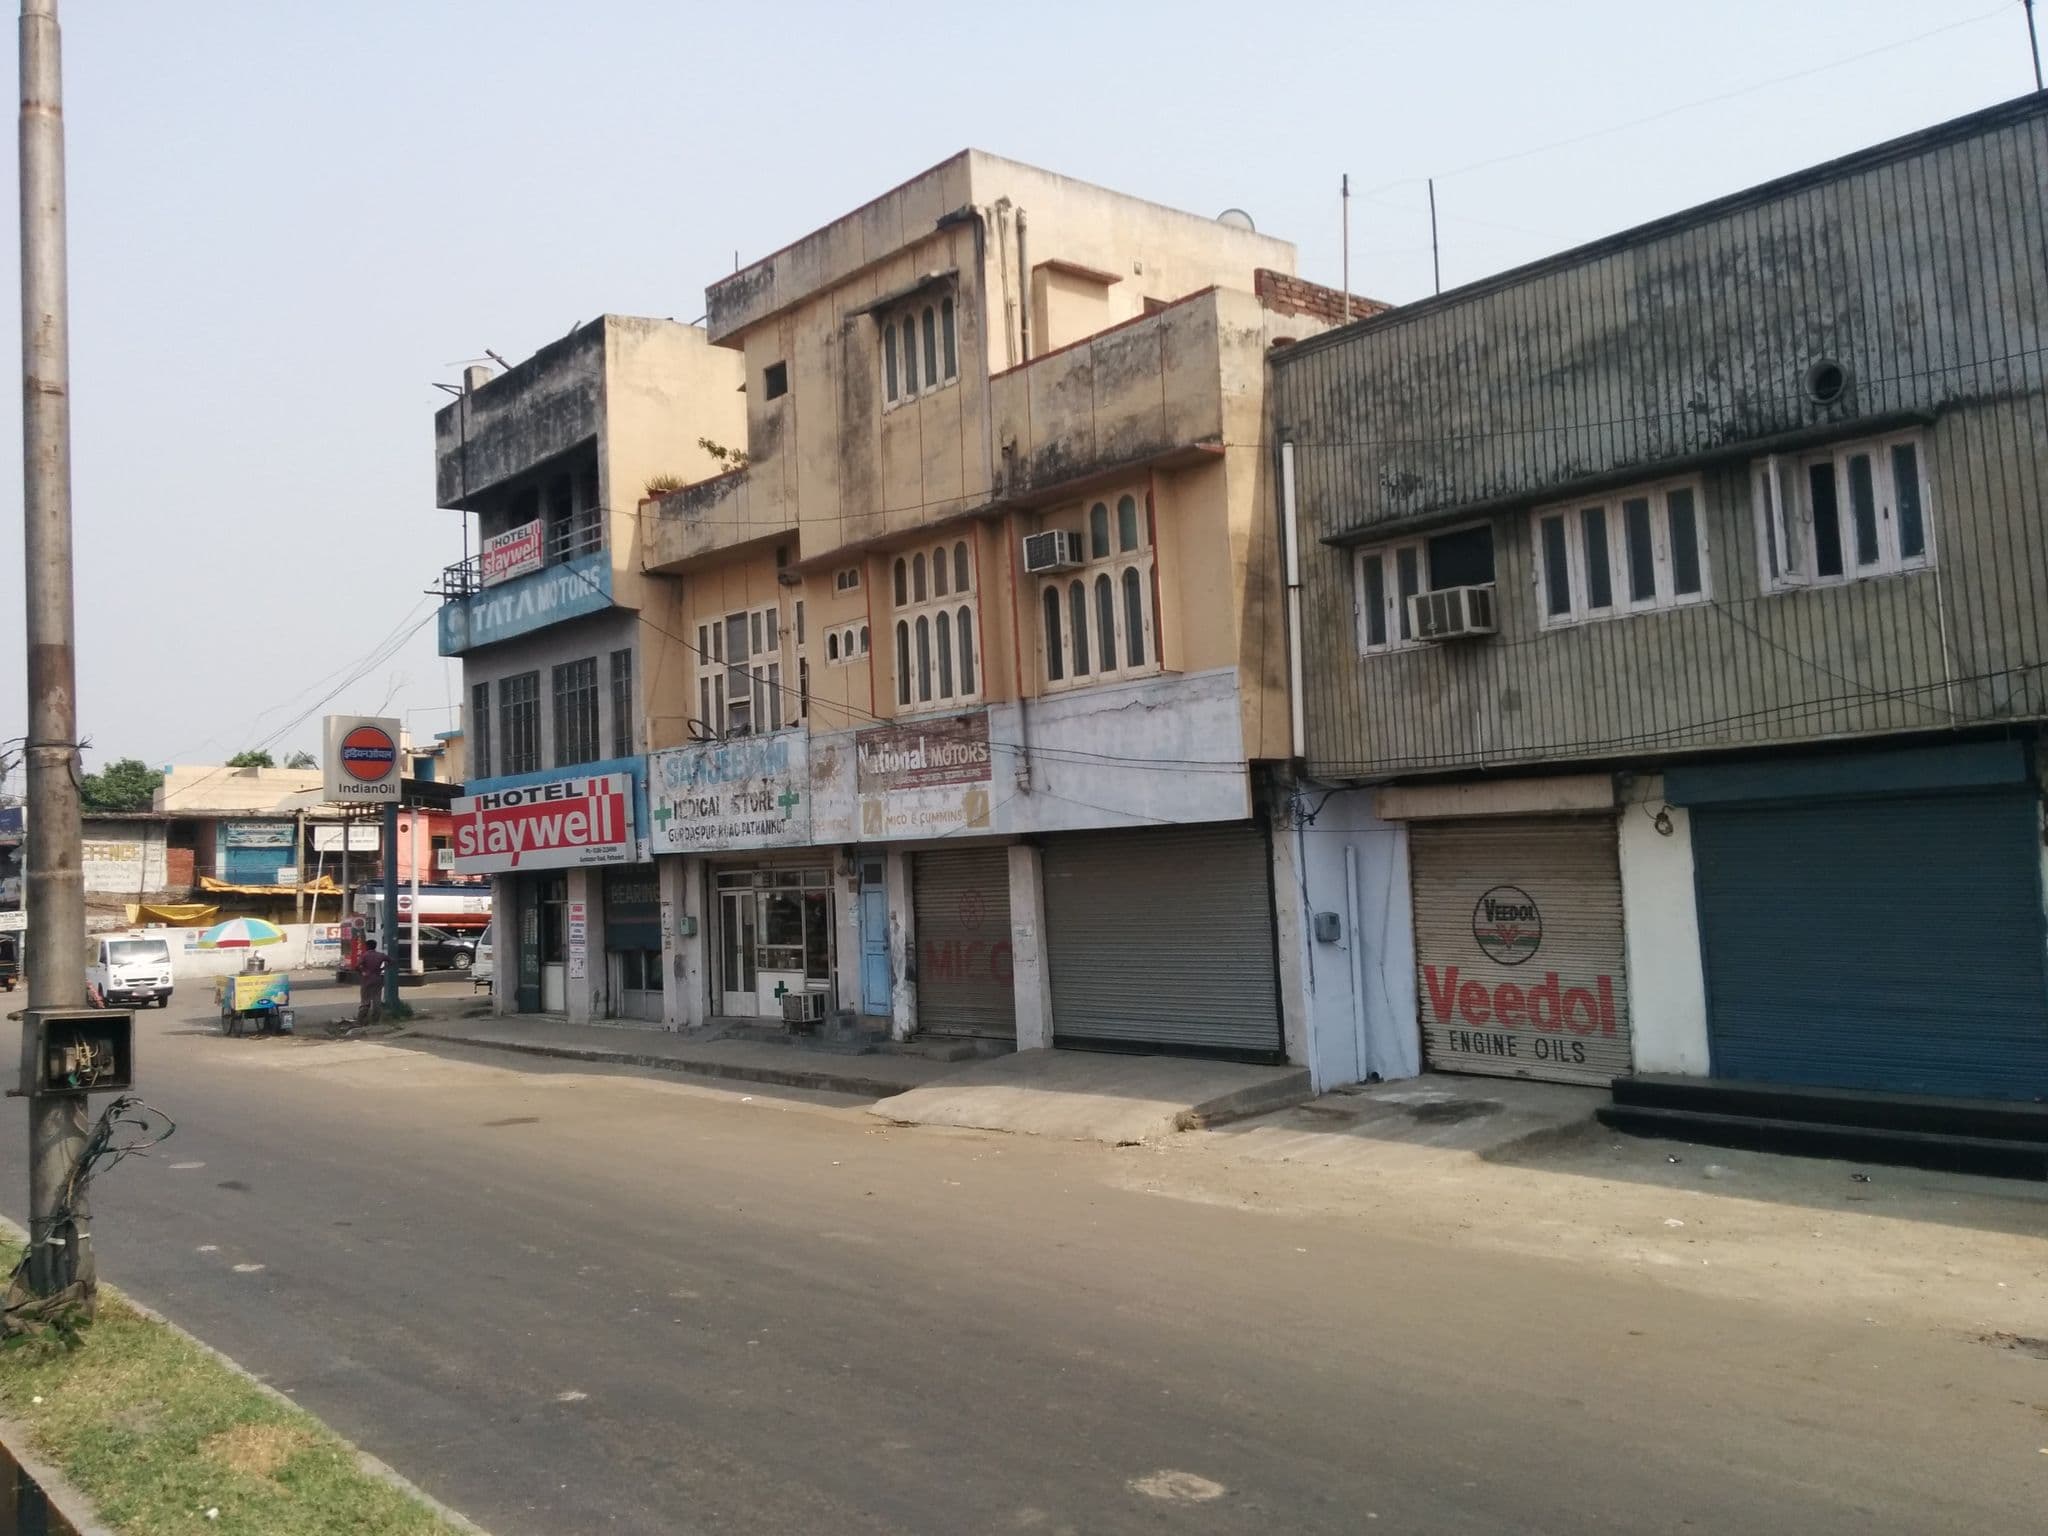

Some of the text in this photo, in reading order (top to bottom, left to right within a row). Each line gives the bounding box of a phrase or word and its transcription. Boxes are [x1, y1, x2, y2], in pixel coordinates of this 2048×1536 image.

[495, 527, 529, 548] HOTEL
[484, 534, 540, 577] staywell
[472, 565, 601, 631] TATA MOTORS
[859, 736, 987, 773] National MOTORS
[338, 784, 395, 794] IndianOil
[483, 782, 583, 809] HOTEL
[458, 790, 612, 866] staywell
[1484, 898, 1535, 922] VEEDOL
[1424, 964, 1617, 1039] Veedol
[1449, 1030, 1586, 1063] ENGINE OILS
